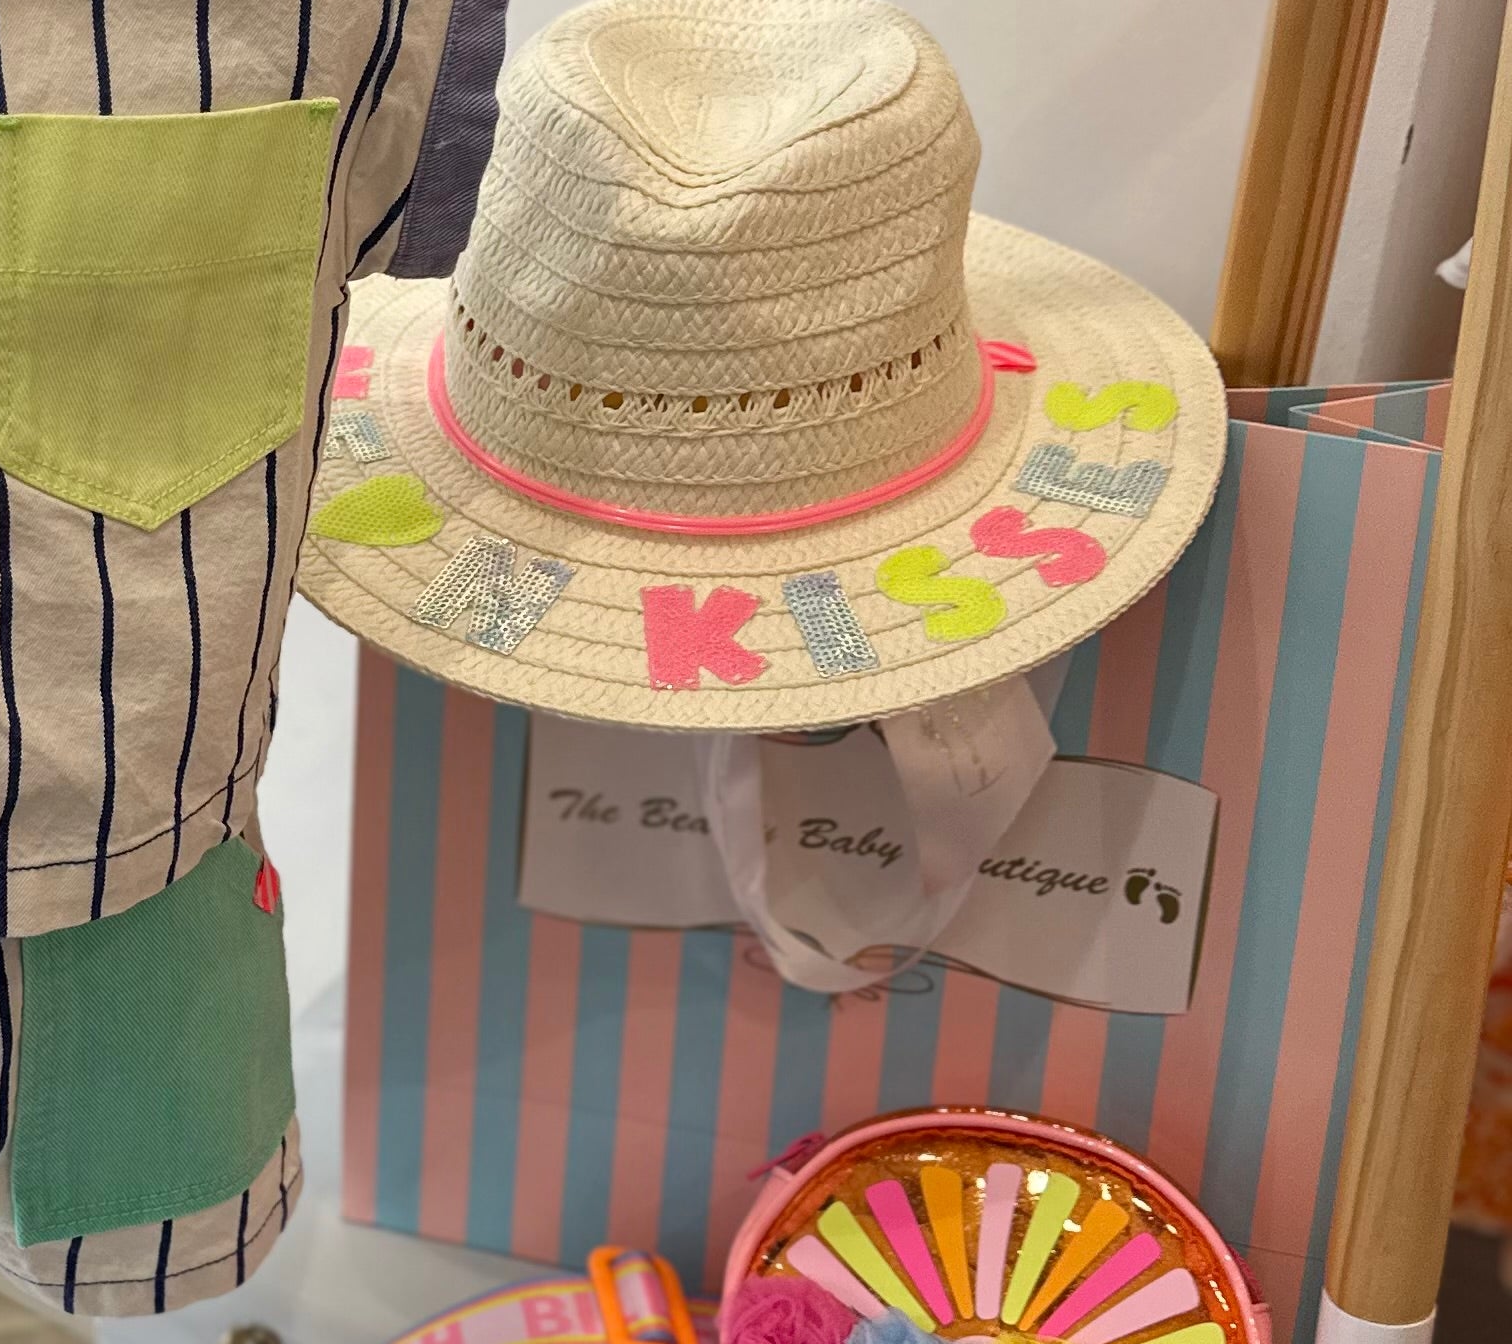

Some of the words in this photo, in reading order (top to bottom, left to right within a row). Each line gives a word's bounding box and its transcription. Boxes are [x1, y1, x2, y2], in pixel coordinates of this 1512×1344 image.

[640, 379, 1180, 692] KISSES
[549, 788, 620, 824] The
[799, 817, 903, 868] Baby
[978, 856, 1110, 897] utique
